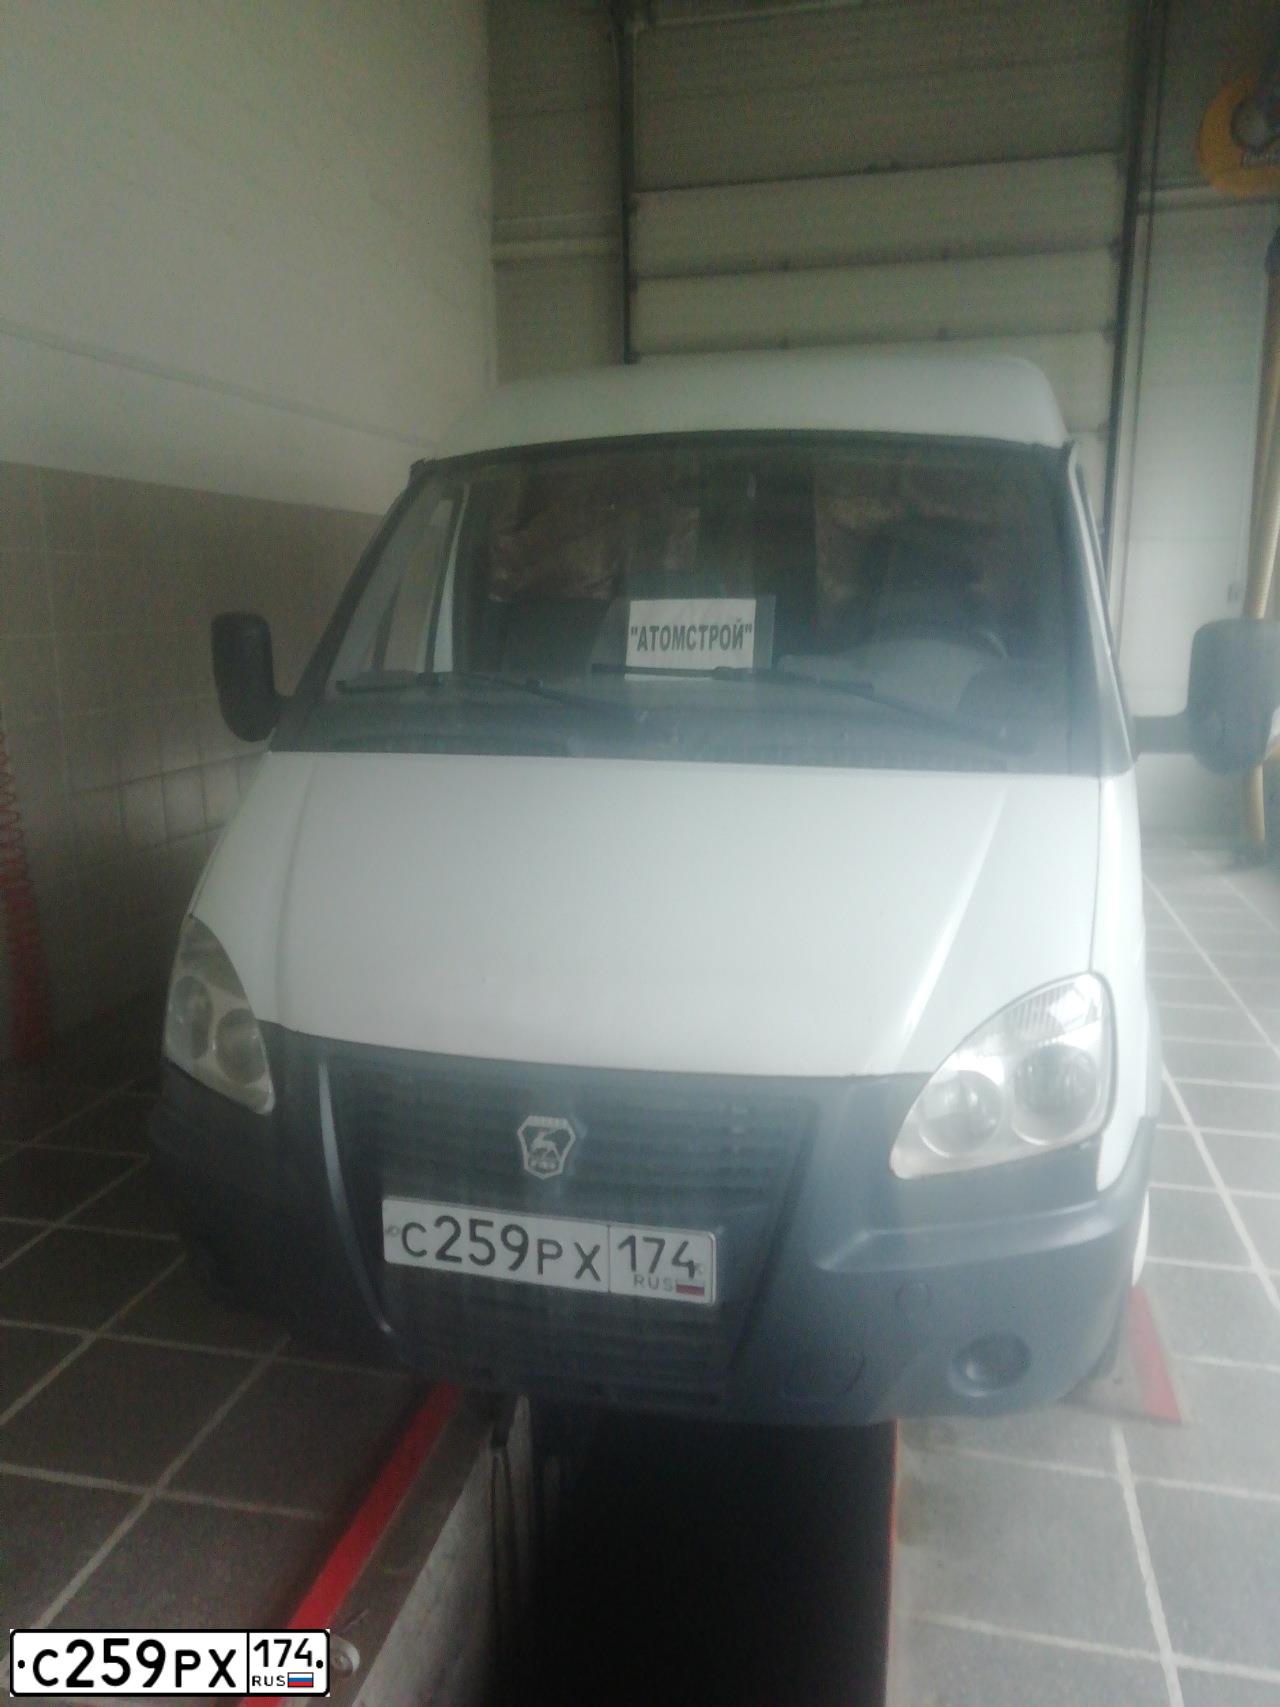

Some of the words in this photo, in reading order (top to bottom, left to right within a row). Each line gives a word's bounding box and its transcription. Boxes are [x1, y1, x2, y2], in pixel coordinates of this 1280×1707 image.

[630, 618, 752, 651] "АТОМСТРОЙ"
[618, 1235, 697, 1279] 174
[633, 1274, 675, 1293] RUS
